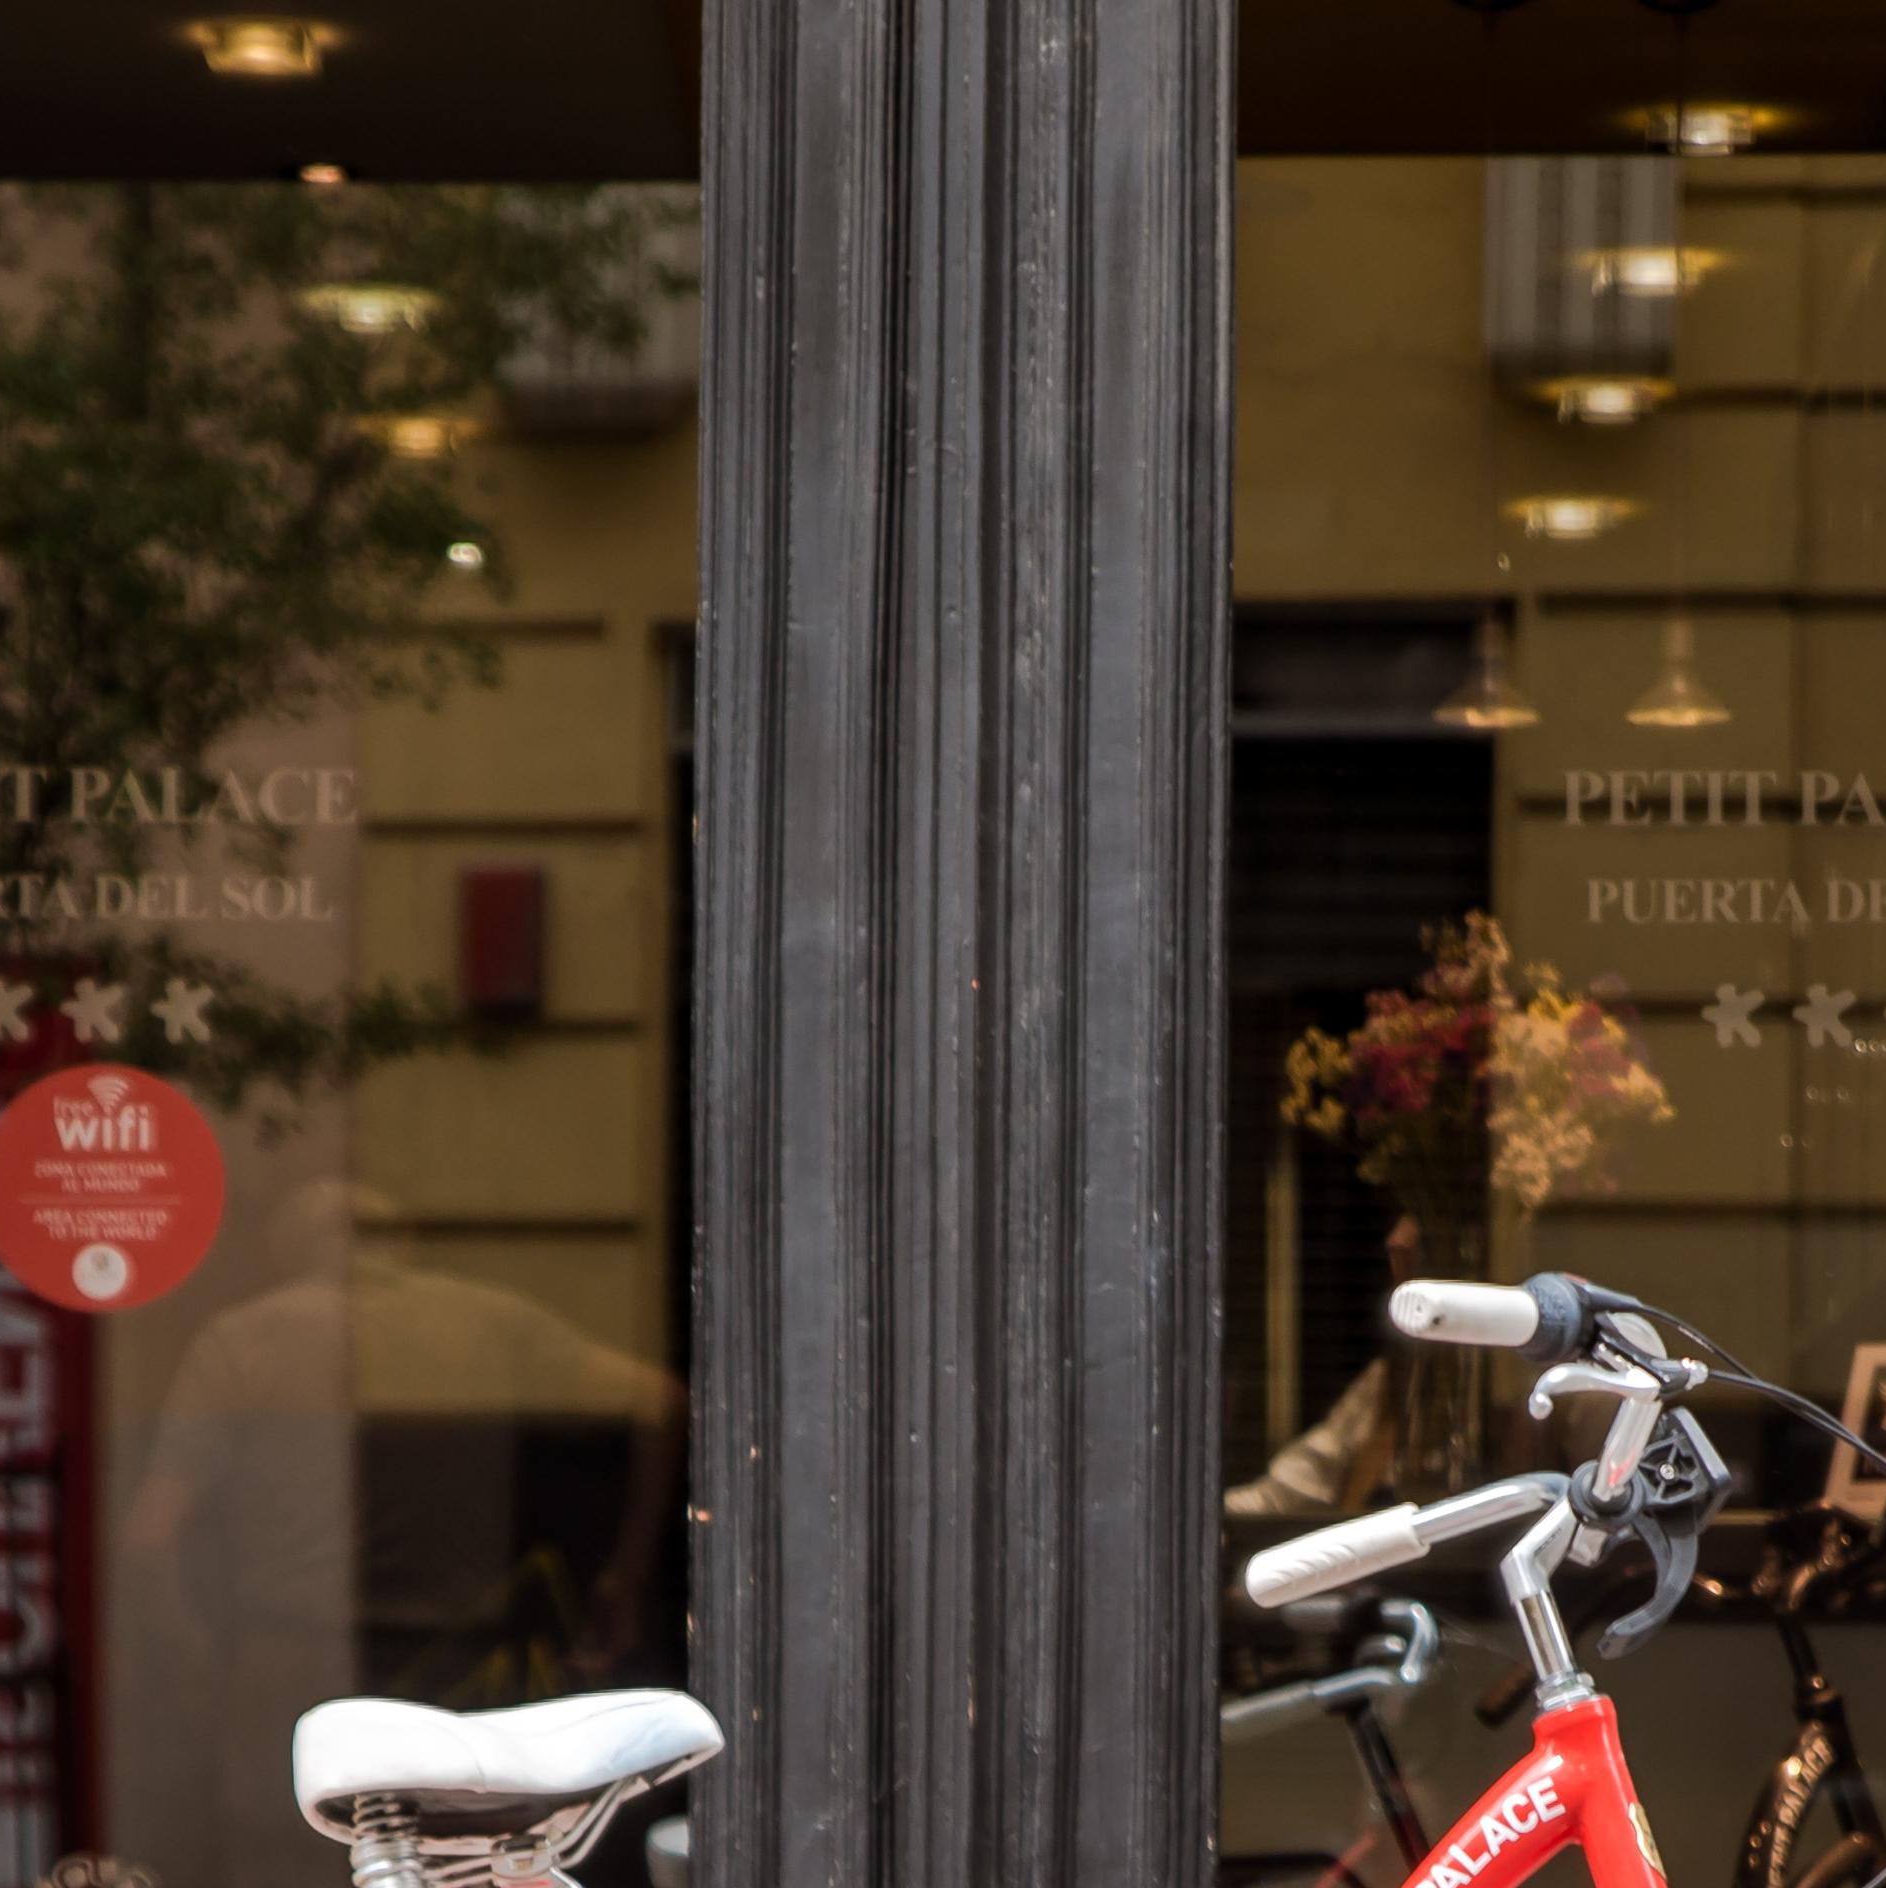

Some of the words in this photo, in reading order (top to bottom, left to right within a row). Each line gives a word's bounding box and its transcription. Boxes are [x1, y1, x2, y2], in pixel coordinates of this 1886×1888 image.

[70, 764, 359, 825] PALACE
[1562, 769, 1779, 828] PETIT
[94, 872, 209, 920] DEL
[221, 873, 334, 922] SOL
[1585, 878, 1812, 924] PUERTA
[54, 1104, 154, 1152] wifi
